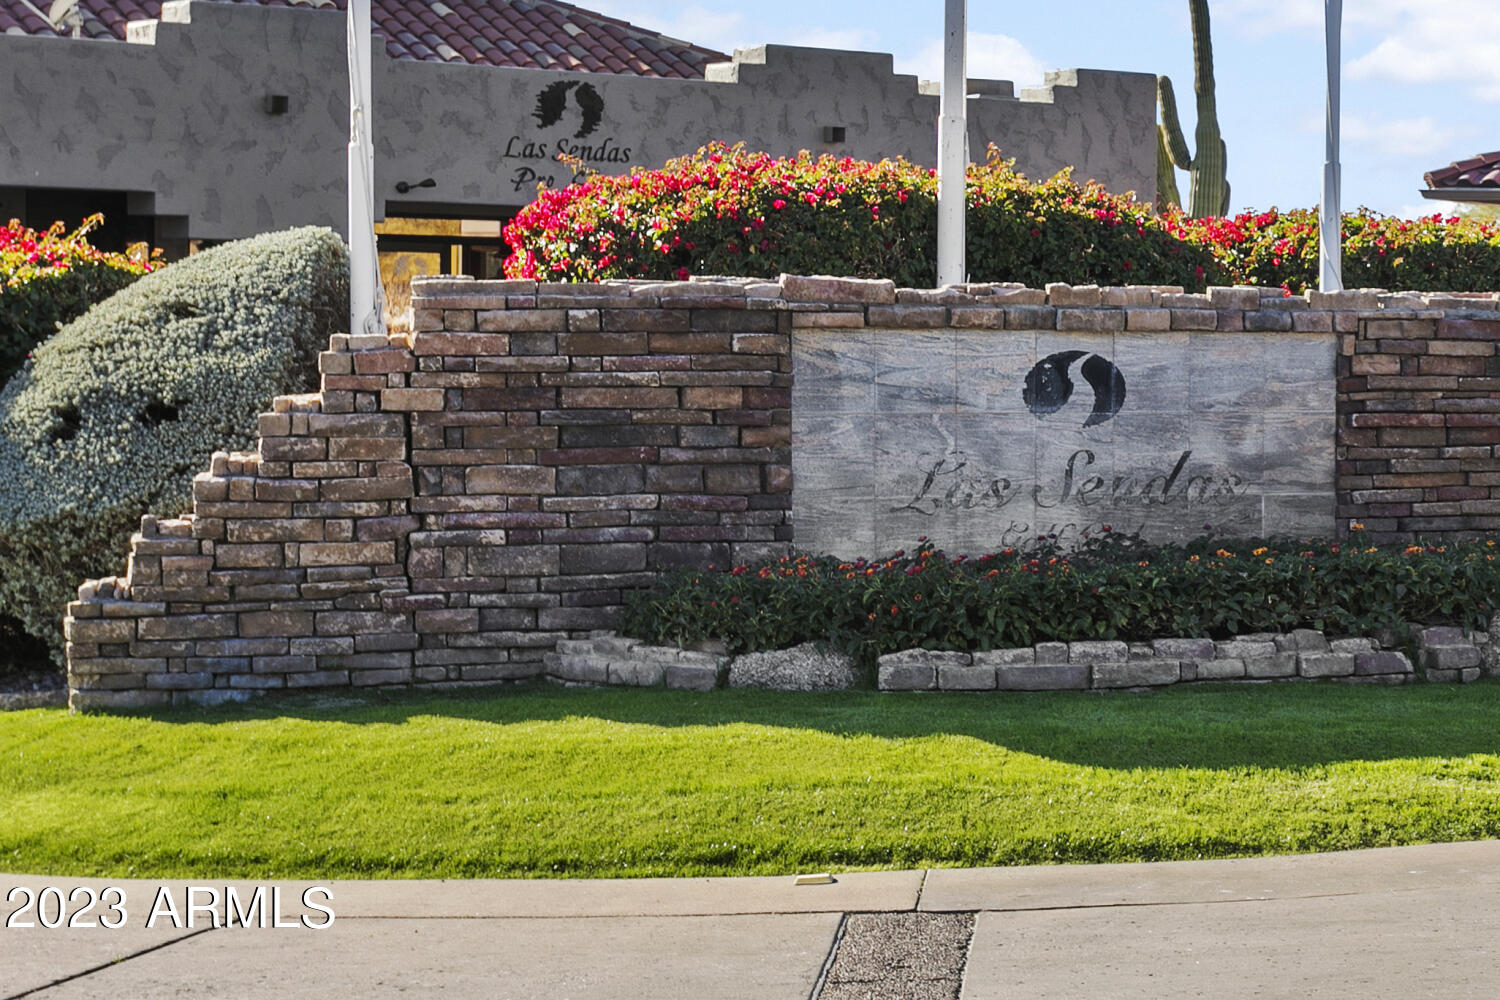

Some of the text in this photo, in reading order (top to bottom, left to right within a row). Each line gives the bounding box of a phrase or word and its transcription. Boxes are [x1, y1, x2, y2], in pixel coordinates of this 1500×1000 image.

[503, 136, 631, 163] Las Sendas
[510, 167, 555, 192] Pro
[890, 449, 1254, 516] Las Sendas
